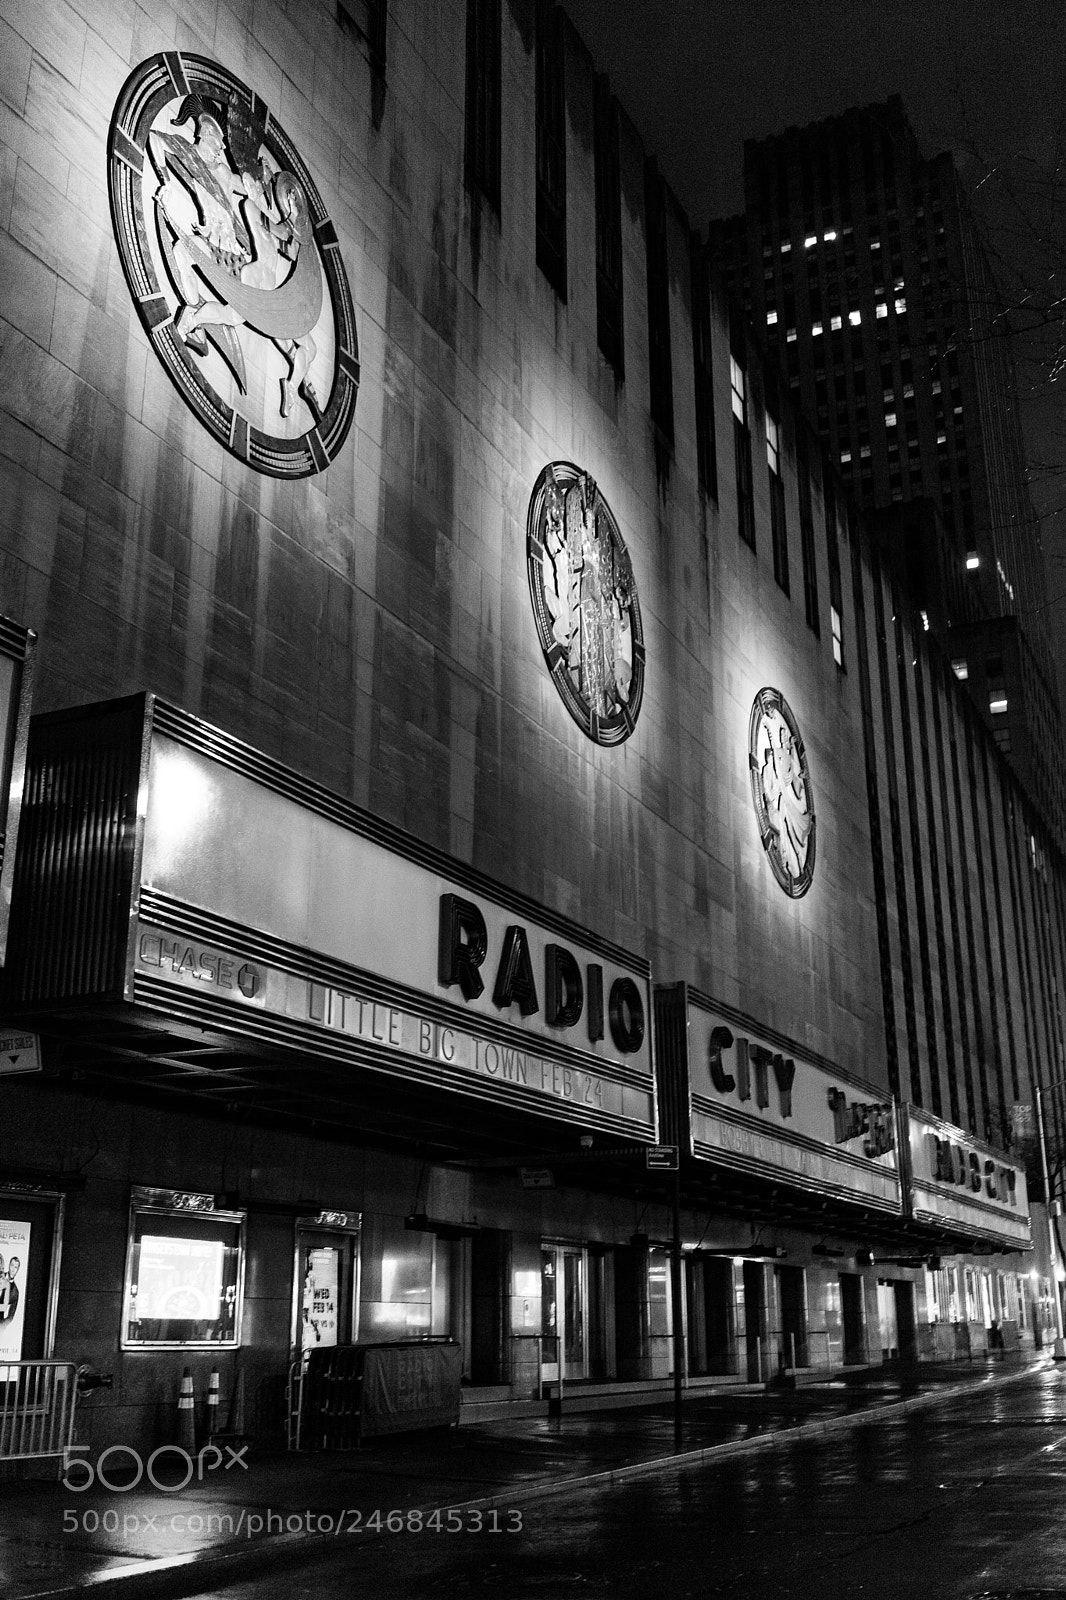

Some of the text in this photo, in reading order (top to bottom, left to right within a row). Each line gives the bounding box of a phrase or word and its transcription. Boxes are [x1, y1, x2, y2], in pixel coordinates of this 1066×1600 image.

[139, 933, 235, 990] CHASE
[437, 893, 645, 1054] RADIO
[308, 982, 602, 1108] LITTLE BIG TOWN FEB 24
[708, 1026, 796, 1119] CITY
[312, 1301, 334, 1314] FEB 14
[313, 1288, 330, 1300] WED
